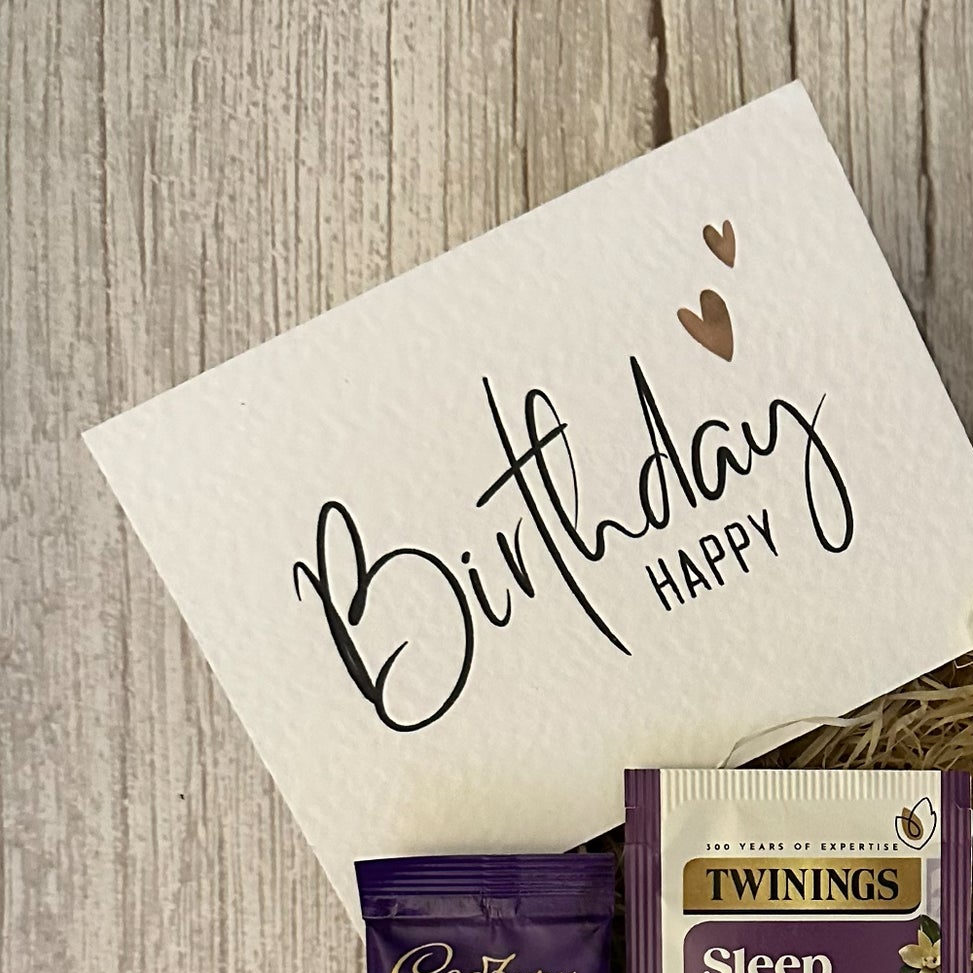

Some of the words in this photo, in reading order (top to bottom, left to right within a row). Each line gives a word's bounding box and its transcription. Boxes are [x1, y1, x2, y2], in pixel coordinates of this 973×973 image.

[293, 356, 853, 732] Birthday
[646, 509, 778, 612] HAPPY
[706, 842, 730, 851] 300
[739, 842, 785, 851] YEARS
[794, 842, 811, 851] OF
[821, 842, 899, 851] EXPERTISE
[706, 868, 899, 901] TWININGS
